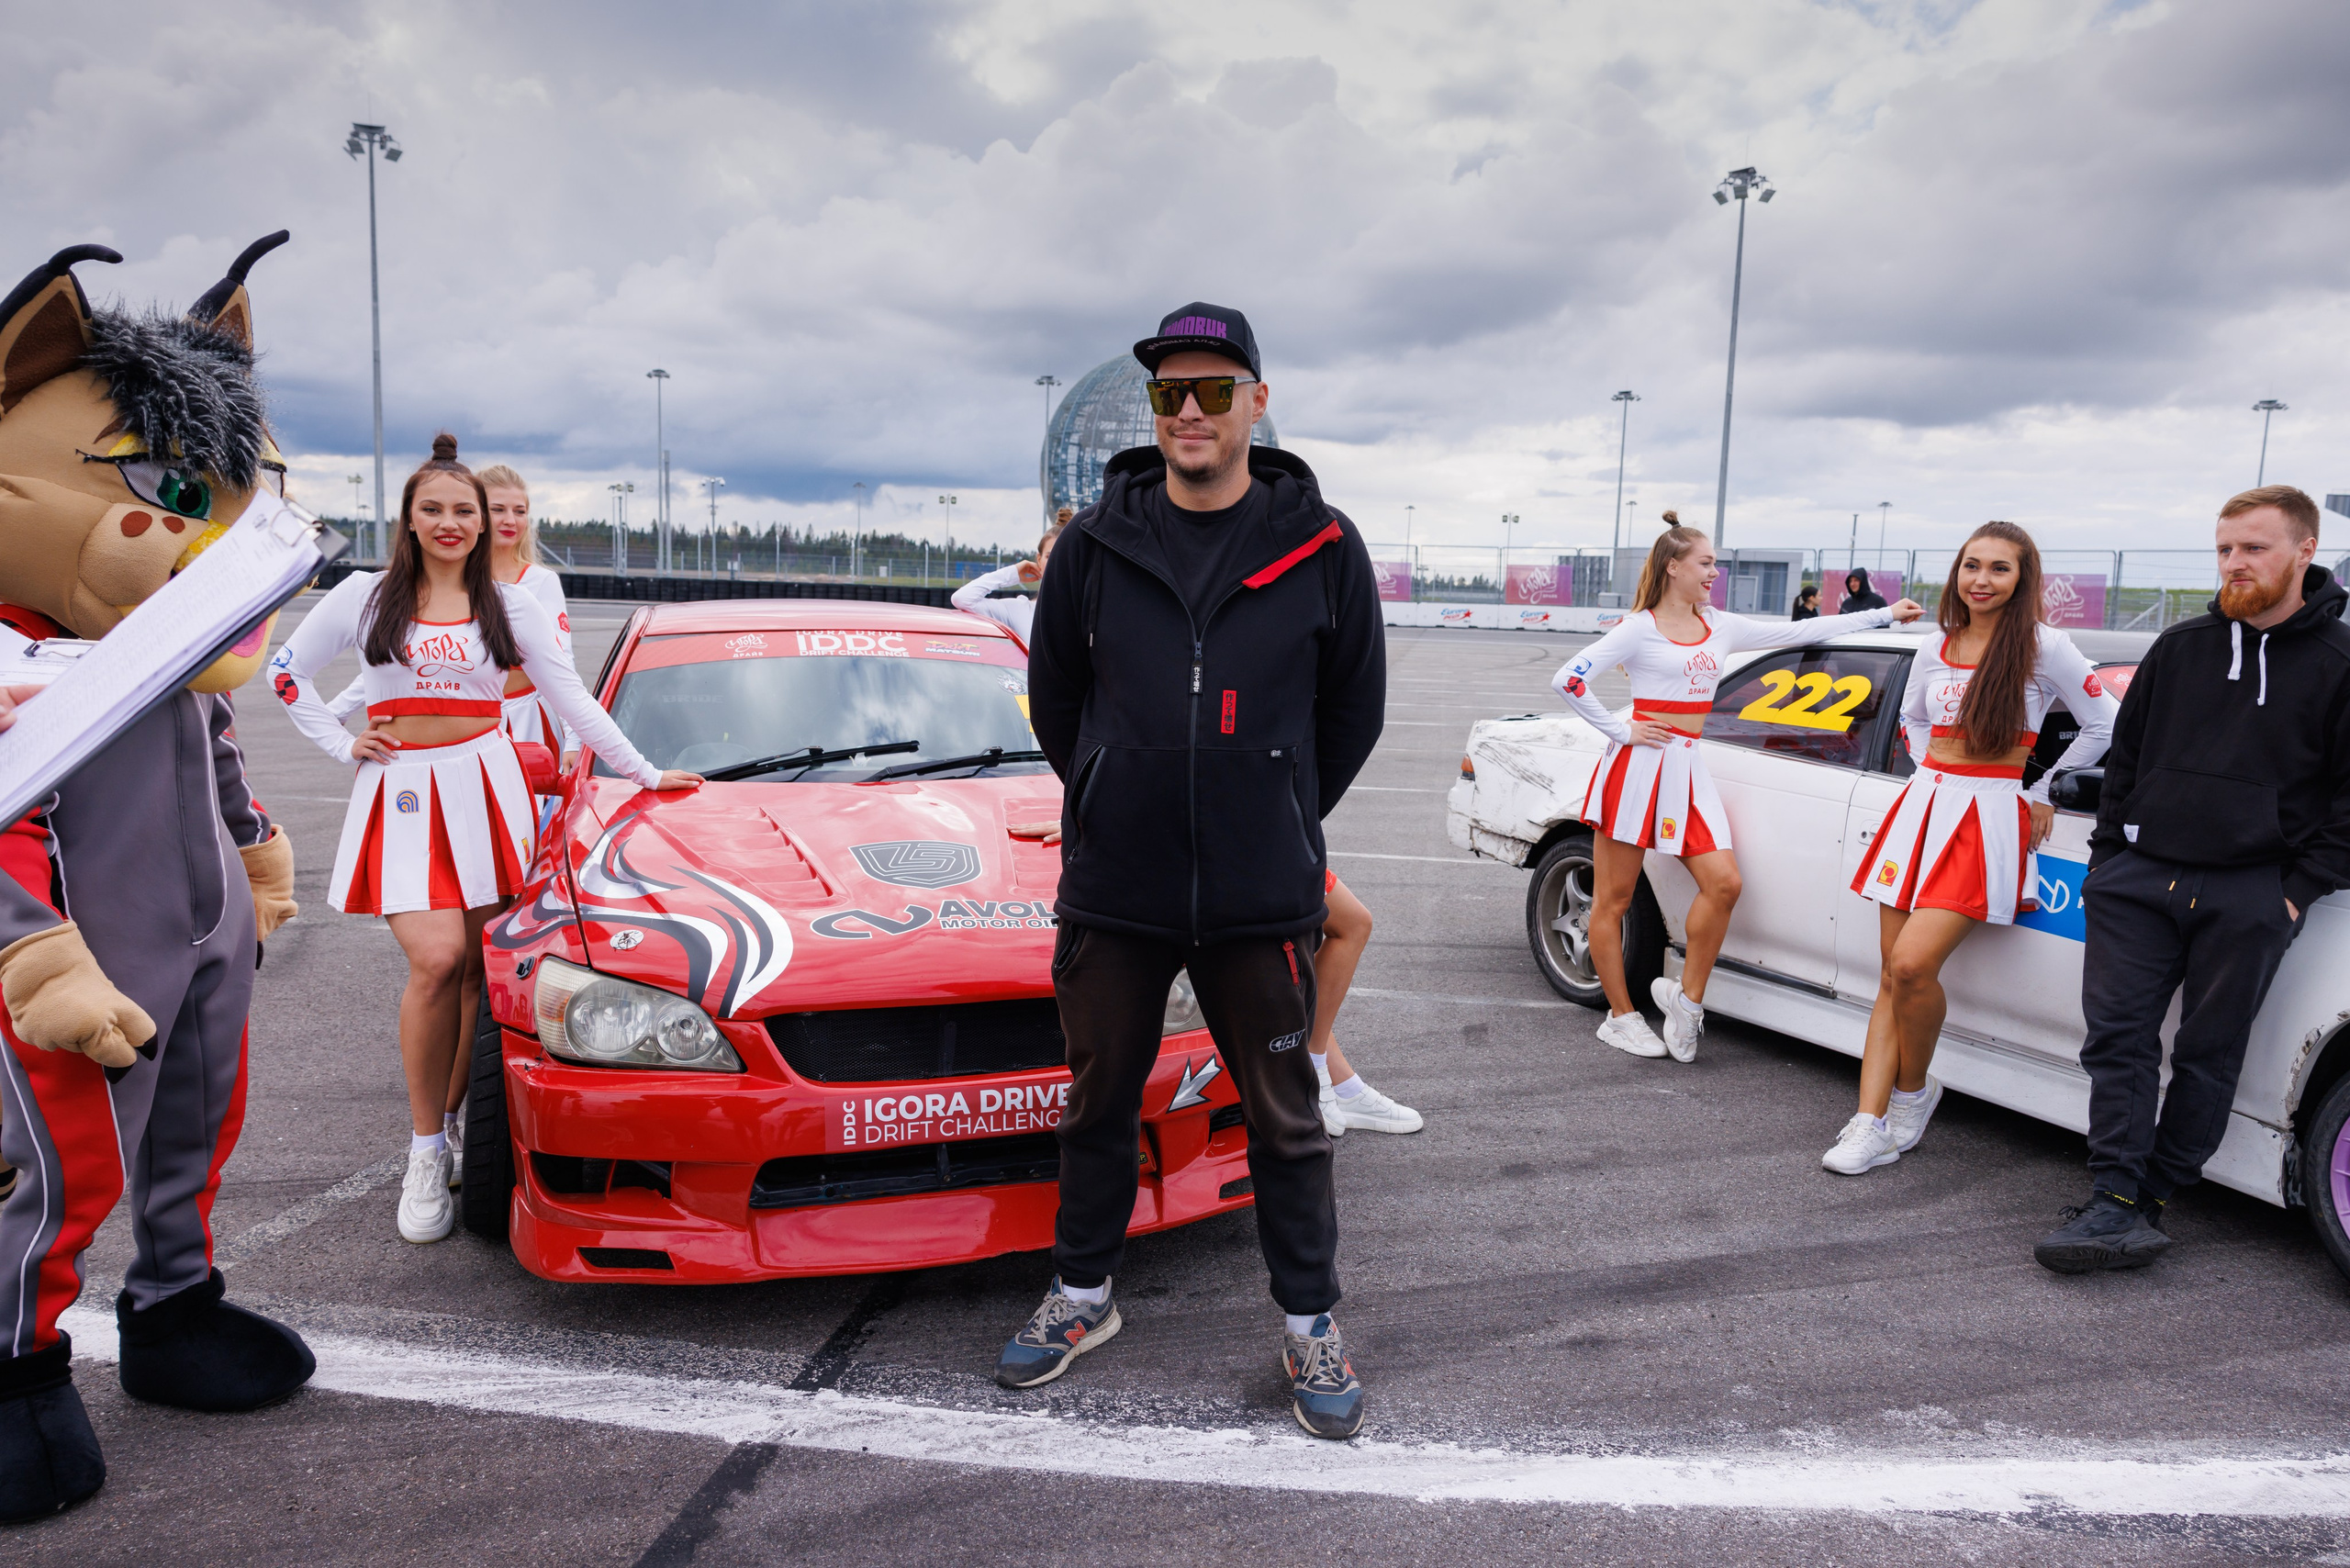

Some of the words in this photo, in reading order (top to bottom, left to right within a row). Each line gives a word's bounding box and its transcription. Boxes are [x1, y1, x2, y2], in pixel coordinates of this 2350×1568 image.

[796, 634, 907, 652] IDDC
[416, 680, 461, 691] ДРАЙВ
[1737, 668, 1873, 733] 222
[2059, 731, 2079, 740] BRI
[937, 900, 1058, 919] AVOL
[941, 919, 1023, 929] MOTOR
[865, 1092, 971, 1124] IGORA
[979, 1082, 1074, 1113] DRIVE
[843, 1100, 856, 1146] IDDC
[866, 1120, 934, 1144] DRIFT
[939, 1109, 1060, 1137] CHALLENG
